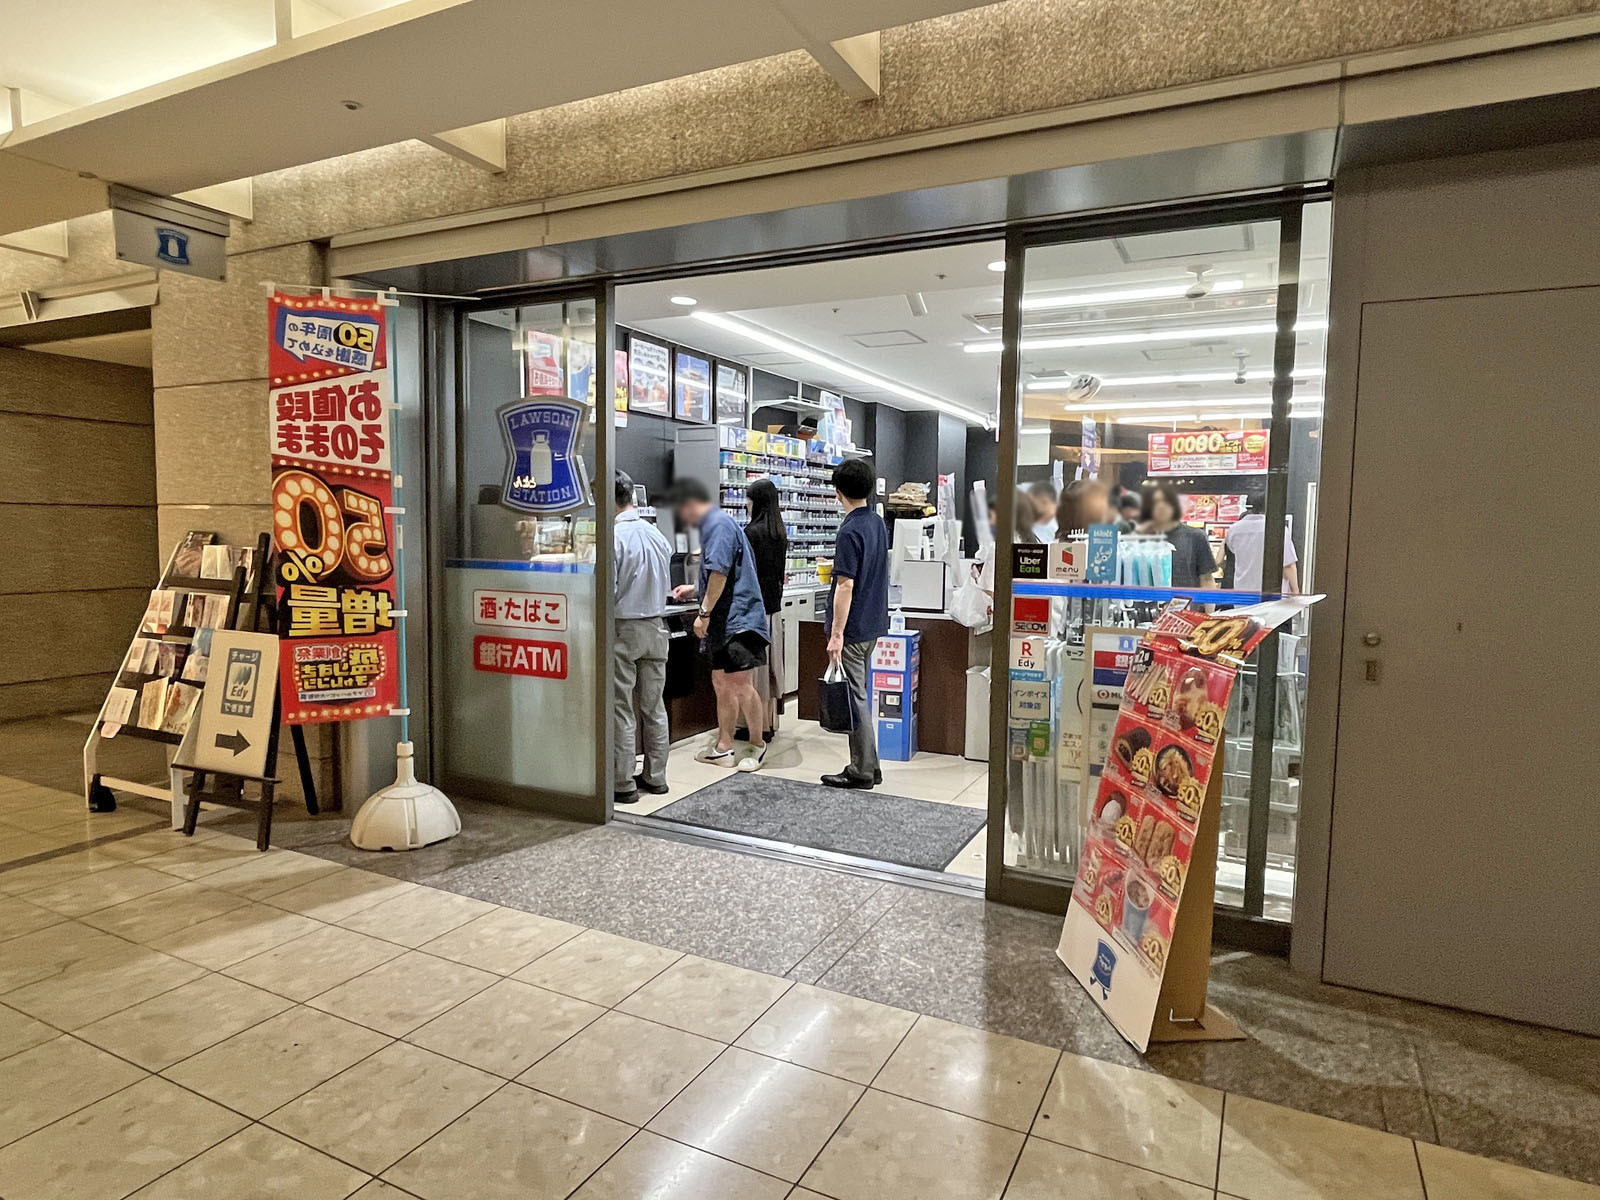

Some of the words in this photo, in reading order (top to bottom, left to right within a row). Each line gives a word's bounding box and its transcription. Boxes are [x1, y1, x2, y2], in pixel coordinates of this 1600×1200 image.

[510, 411, 572, 429] LAWSON
[513, 486, 571, 502] STATION
[1020, 556, 1041, 565] Uber
[1020, 565, 1041, 573] Eats
[480, 597, 560, 624] 酒・たばこ
[1014, 621, 1047, 632] SECOM
[1021, 642, 1033, 656] R
[231, 651, 259, 662] チャージ
[480, 642, 561, 673] 銀行ATM
[1018, 659, 1035, 669] Edy
[230, 685, 248, 699] Edy
